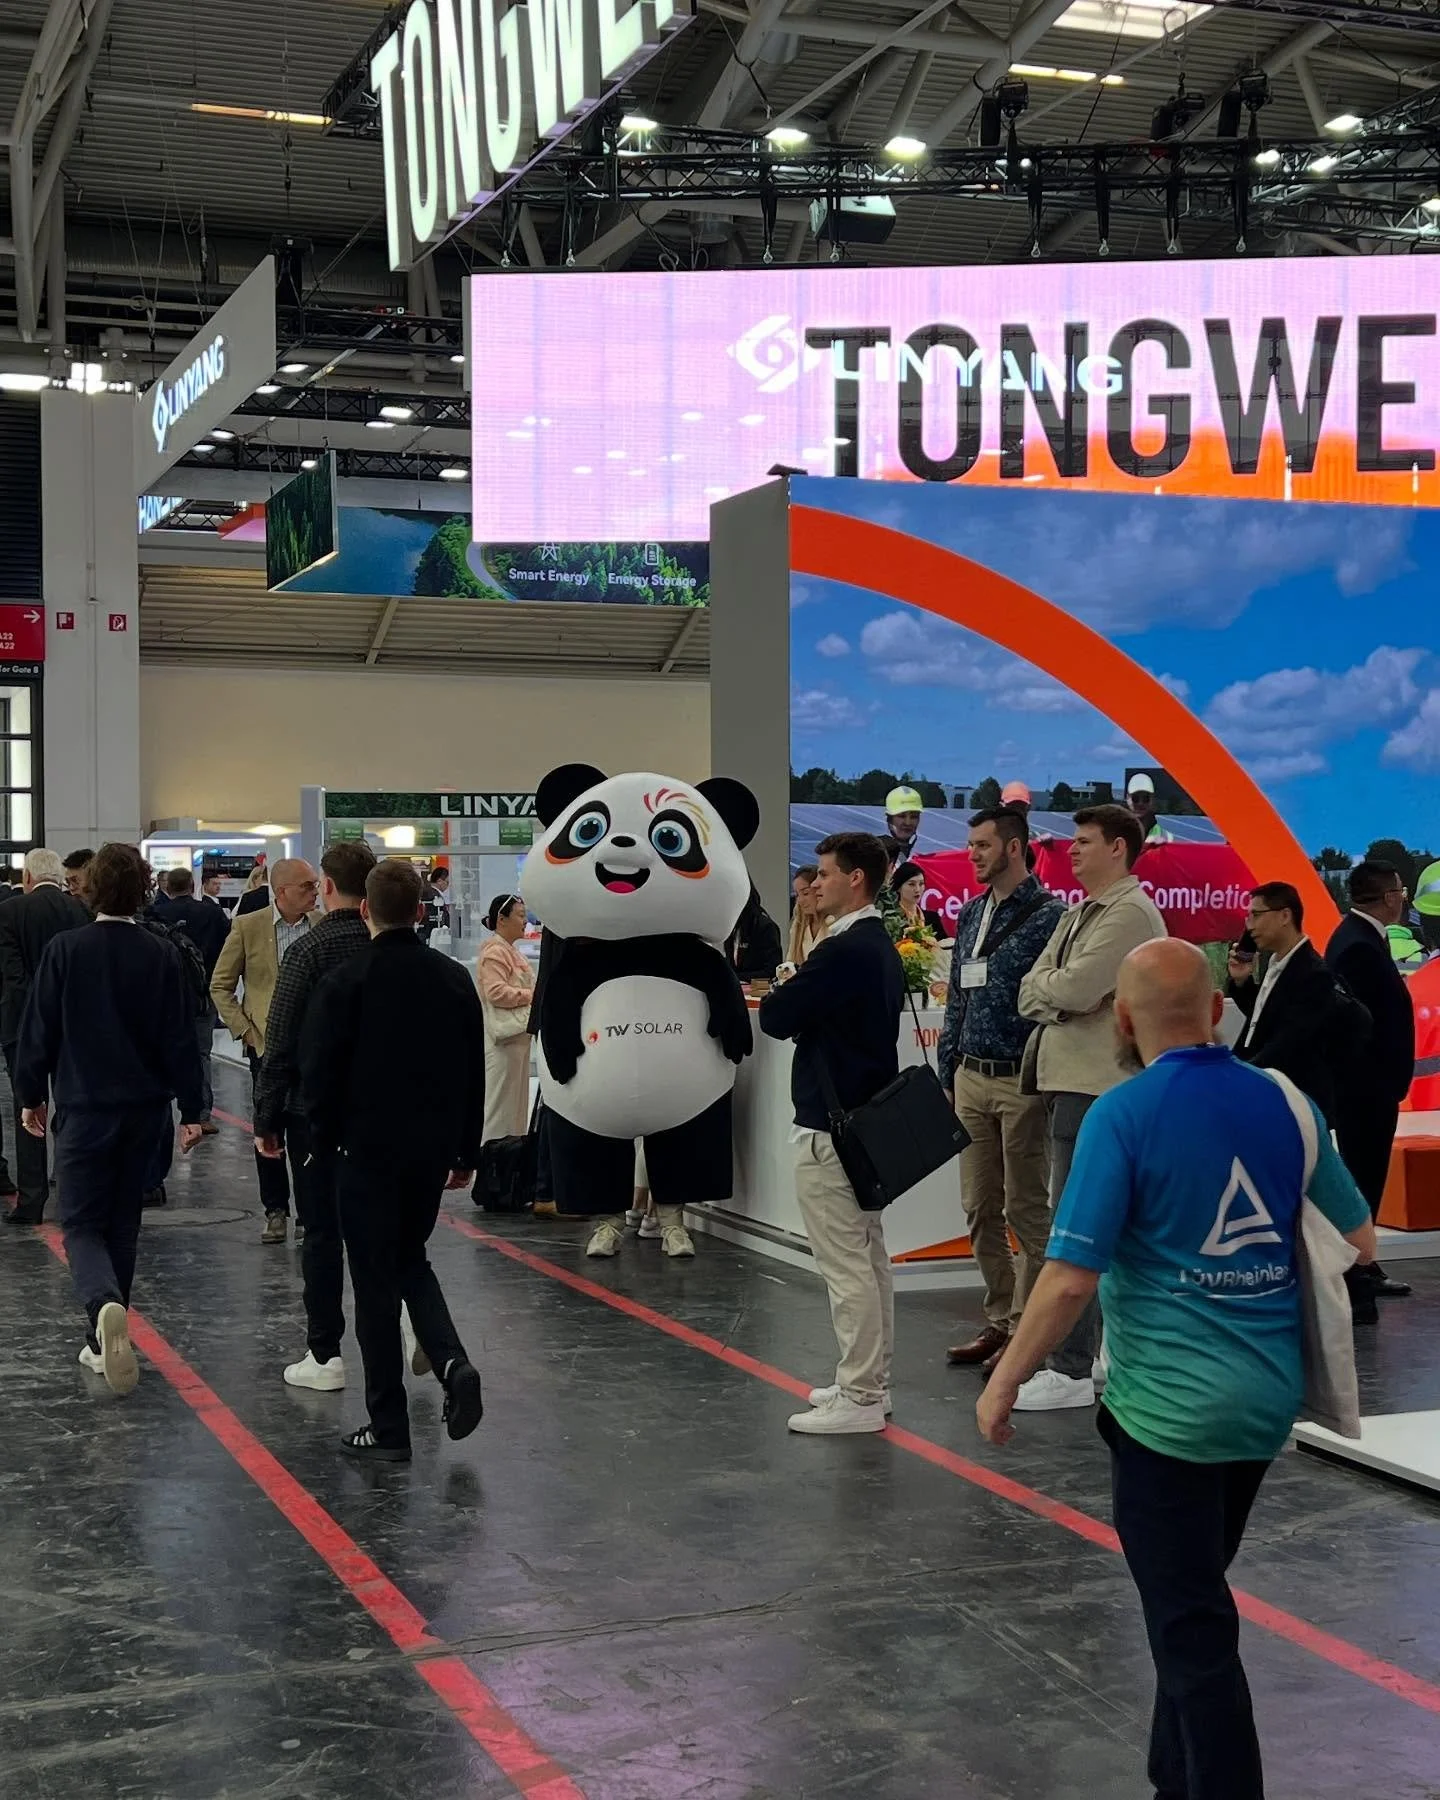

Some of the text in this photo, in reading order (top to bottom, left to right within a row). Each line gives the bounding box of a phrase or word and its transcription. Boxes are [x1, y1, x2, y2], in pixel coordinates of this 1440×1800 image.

[371, 0, 674, 272] TONGW
[832, 340, 1124, 395] LINYANG
[168, 335, 225, 426] LINYANG
[804, 312, 1438, 481] TONGWE
[508, 567, 590, 586] Smart Energy
[608, 572, 697, 589] Energy Storage
[12, 665, 32, 674] Gate
[440, 795, 538, 816] LINYA
[605, 1022, 684, 1038] TW SOLAR
